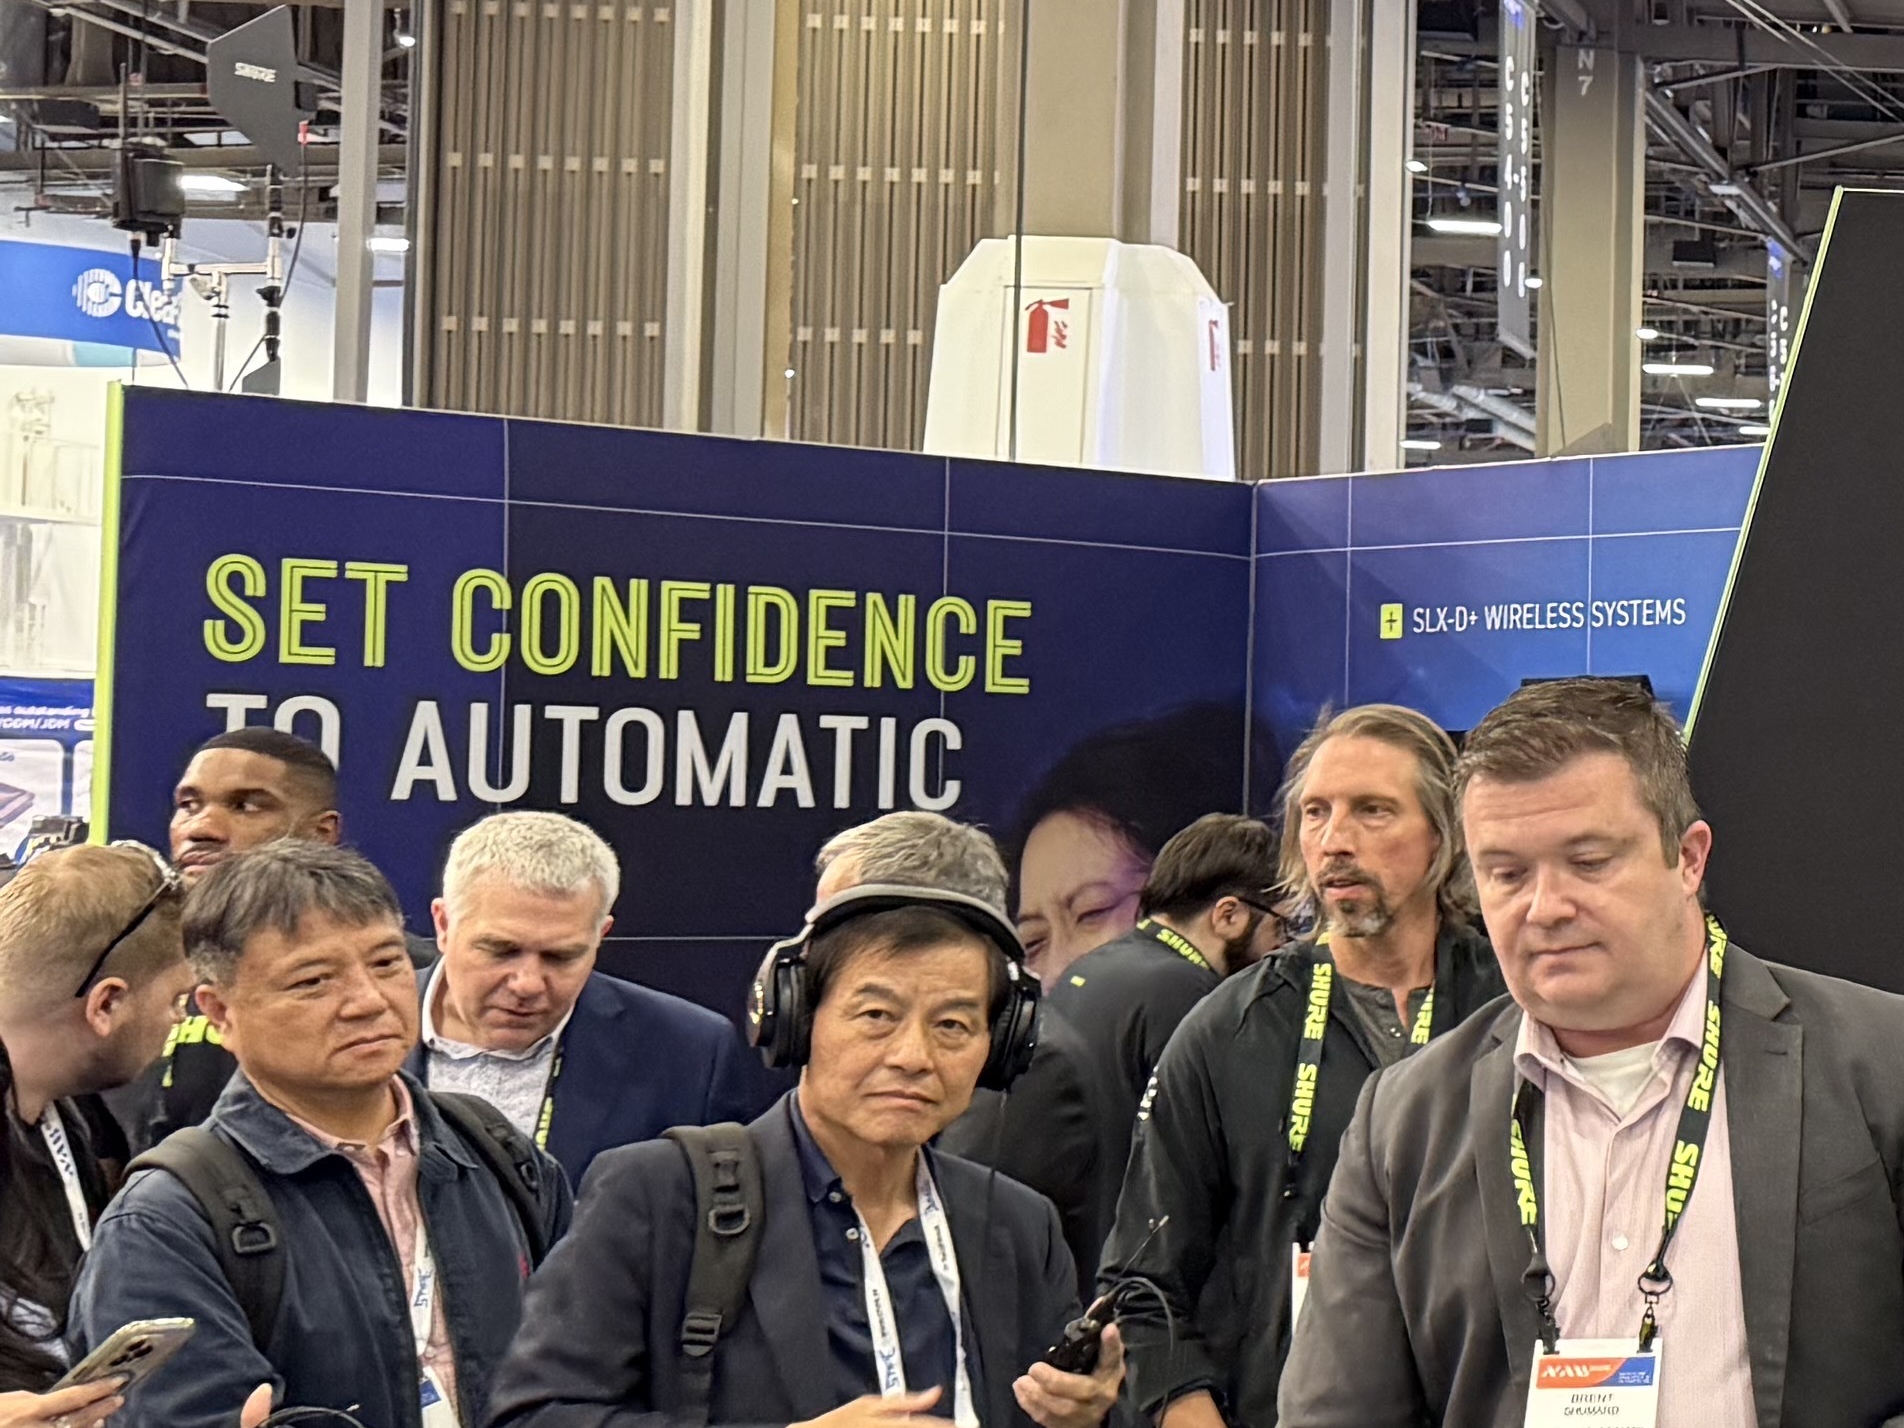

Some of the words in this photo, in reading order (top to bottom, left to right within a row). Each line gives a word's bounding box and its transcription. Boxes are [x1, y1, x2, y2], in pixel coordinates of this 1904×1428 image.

[203, 553, 409, 668] SET
[451, 568, 1033, 695] CONFIDENCE
[1412, 605, 1479, 634] SLX-D+
[1484, 600, 1585, 631] WIRELESS
[1591, 597, 1687, 628] SYSTEMS
[390, 700, 963, 812] AUTOMATIC
[1303, 962, 1333, 1041] SHURE
[1686, 999, 1722, 1113] SHURE
[1288, 1062, 1319, 1153] SHURE
